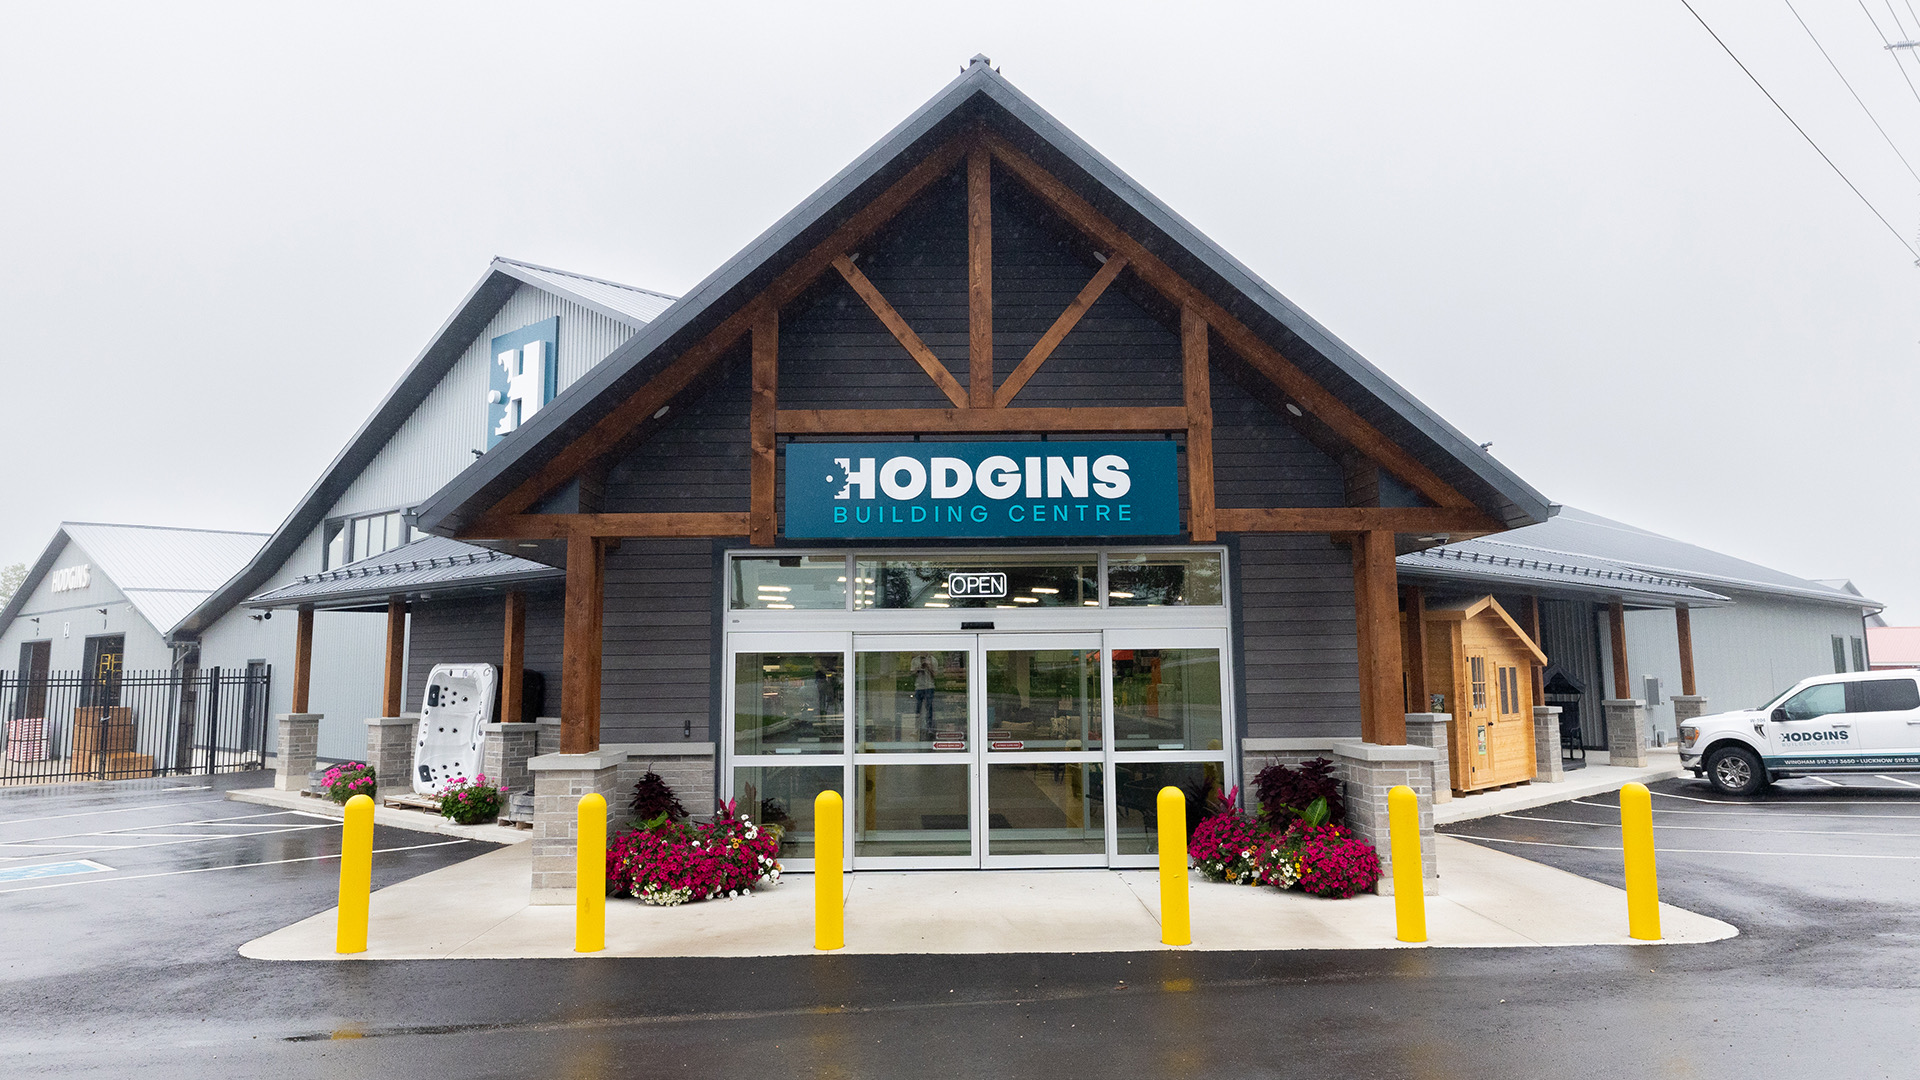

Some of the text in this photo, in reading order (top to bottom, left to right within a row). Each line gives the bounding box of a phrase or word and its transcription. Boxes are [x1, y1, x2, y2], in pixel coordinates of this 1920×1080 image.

[833, 454, 1131, 501] HODGINS
[834, 503, 1132, 524] BUILDING CENTRE
[51, 564, 91, 593] HODGINS
[951, 576, 1004, 594] OPEN
[1780, 730, 1849, 742] HODGINS
